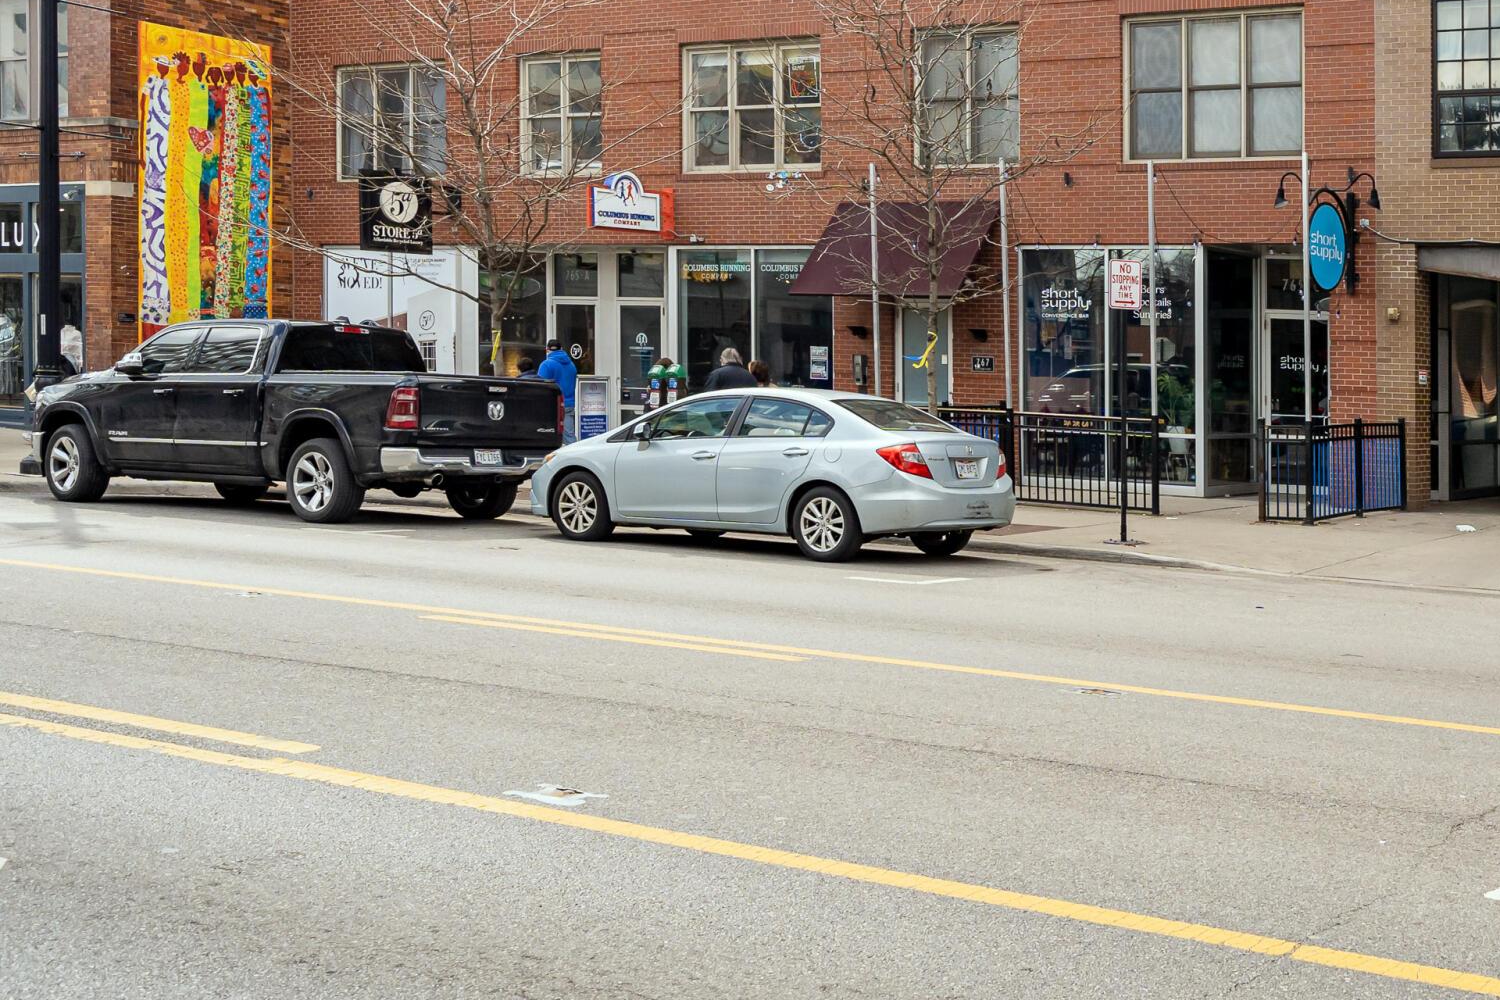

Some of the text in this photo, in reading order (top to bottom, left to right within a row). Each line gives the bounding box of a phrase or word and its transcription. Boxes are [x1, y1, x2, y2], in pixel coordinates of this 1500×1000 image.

[1311, 230, 1337, 246] short
[1310, 245, 1343, 264] supply
[682, 264, 751, 273] COLUMBUS RUNNING
[760, 264, 798, 272] COLUMBUS
[1119, 264, 1132, 274] NO
[1112, 274, 1139, 285] STOPPING
[1041, 287, 1080, 299] short
[1141, 285, 1166, 294] Bers
[1118, 291, 1133, 299] TIME
[1041, 297, 1090, 311] supply
[1133, 310, 1172, 320] Sunries
